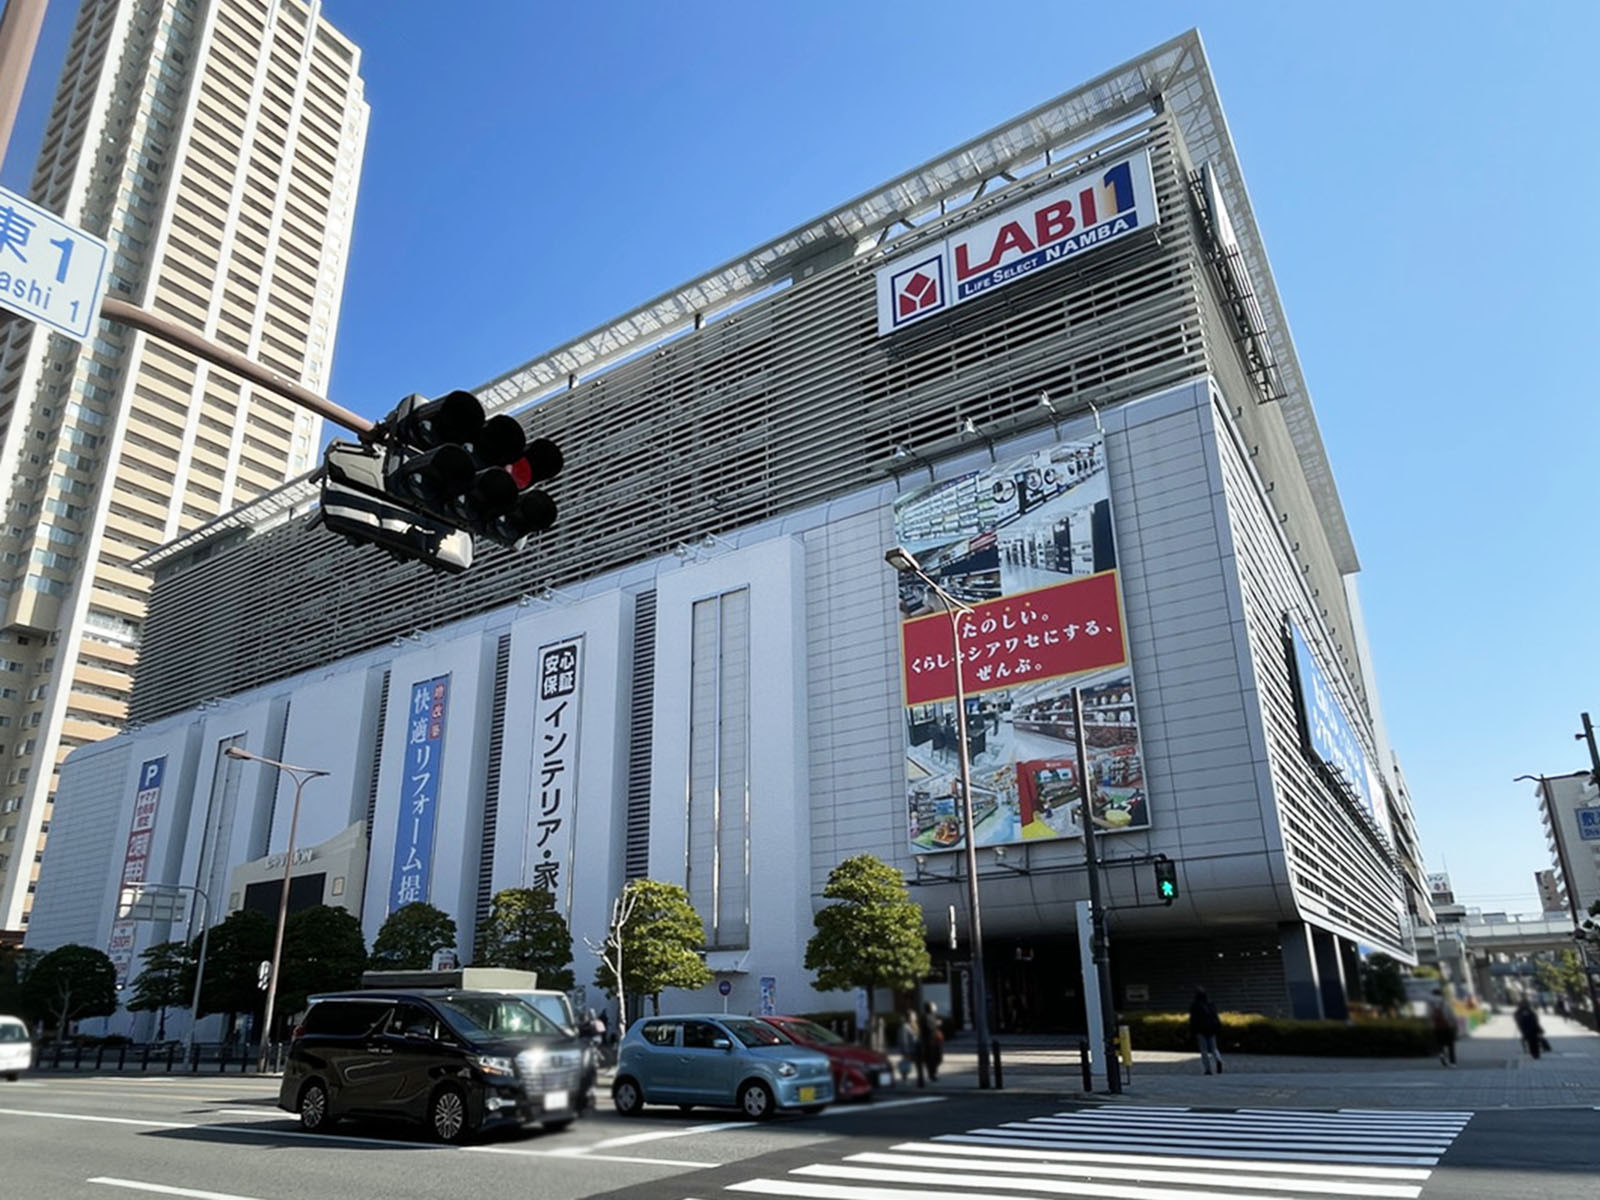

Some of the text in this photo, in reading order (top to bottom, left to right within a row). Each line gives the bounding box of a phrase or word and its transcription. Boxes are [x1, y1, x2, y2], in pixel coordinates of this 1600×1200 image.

[964, 218, 1130, 296] LIFE SELECT NAMBA
[70, 300, 80, 323] 1
[962, 609, 1050, 640] たのしい。
[976, 658, 1043, 682] ぜんぶ。
[144, 764, 159, 787] P
